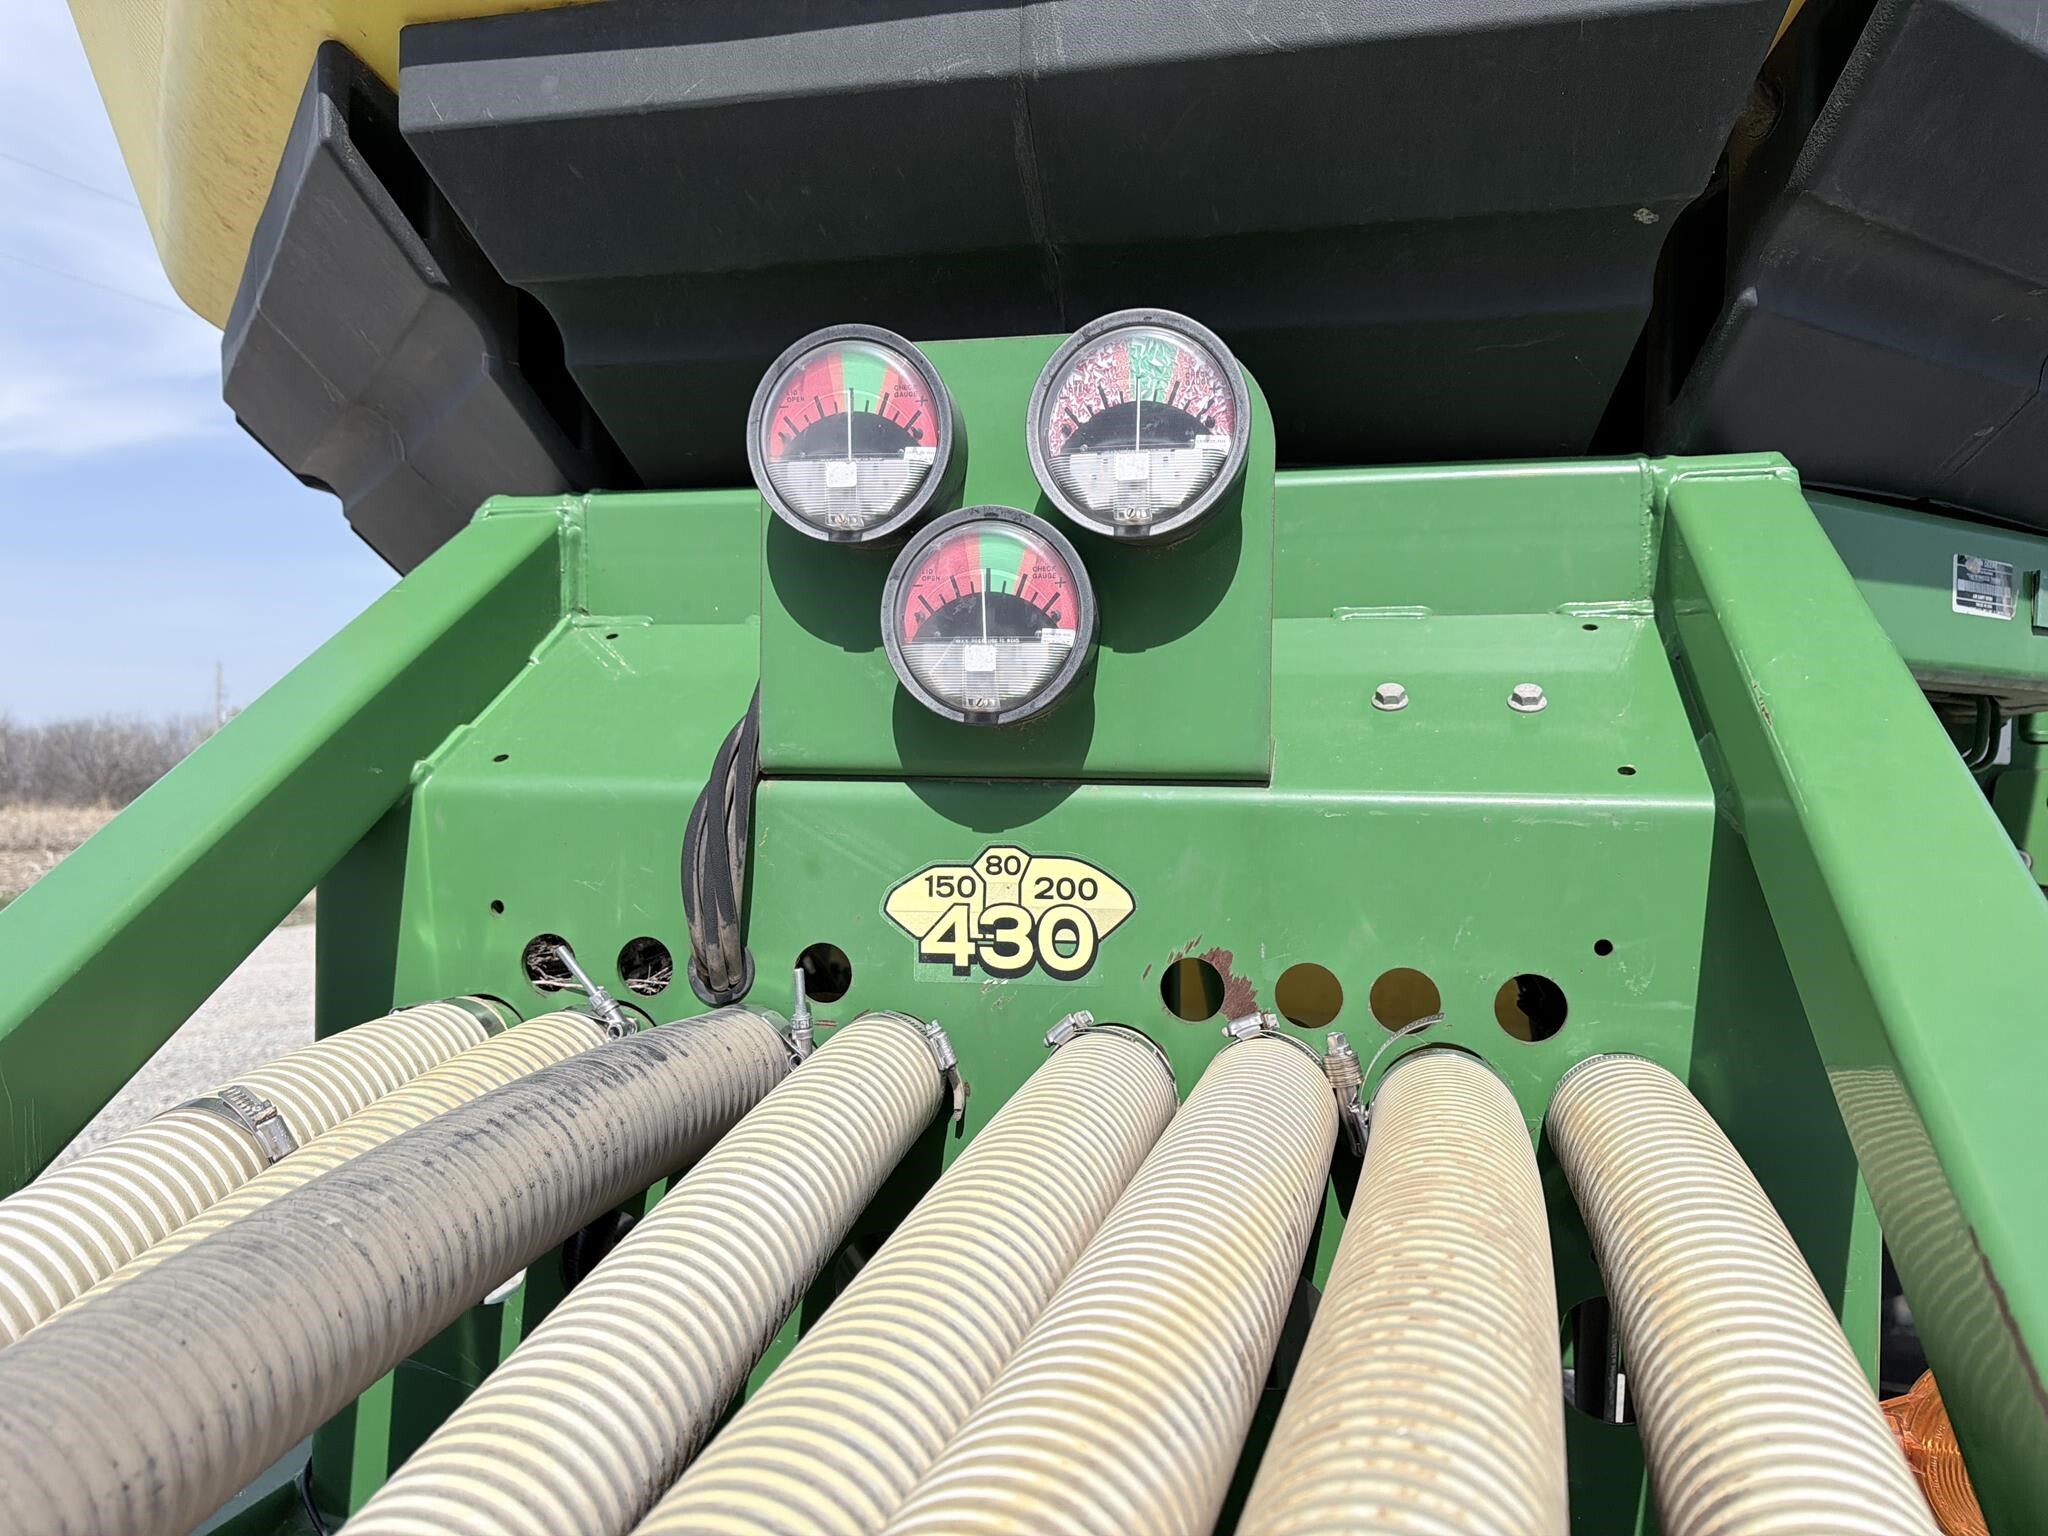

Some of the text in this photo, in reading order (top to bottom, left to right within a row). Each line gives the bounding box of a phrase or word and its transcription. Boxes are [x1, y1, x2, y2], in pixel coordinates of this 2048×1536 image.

[985, 855, 1022, 876] 80
[924, 875, 977, 899] 150
[1033, 876, 1099, 901] 200
[918, 902, 1099, 982] 430
